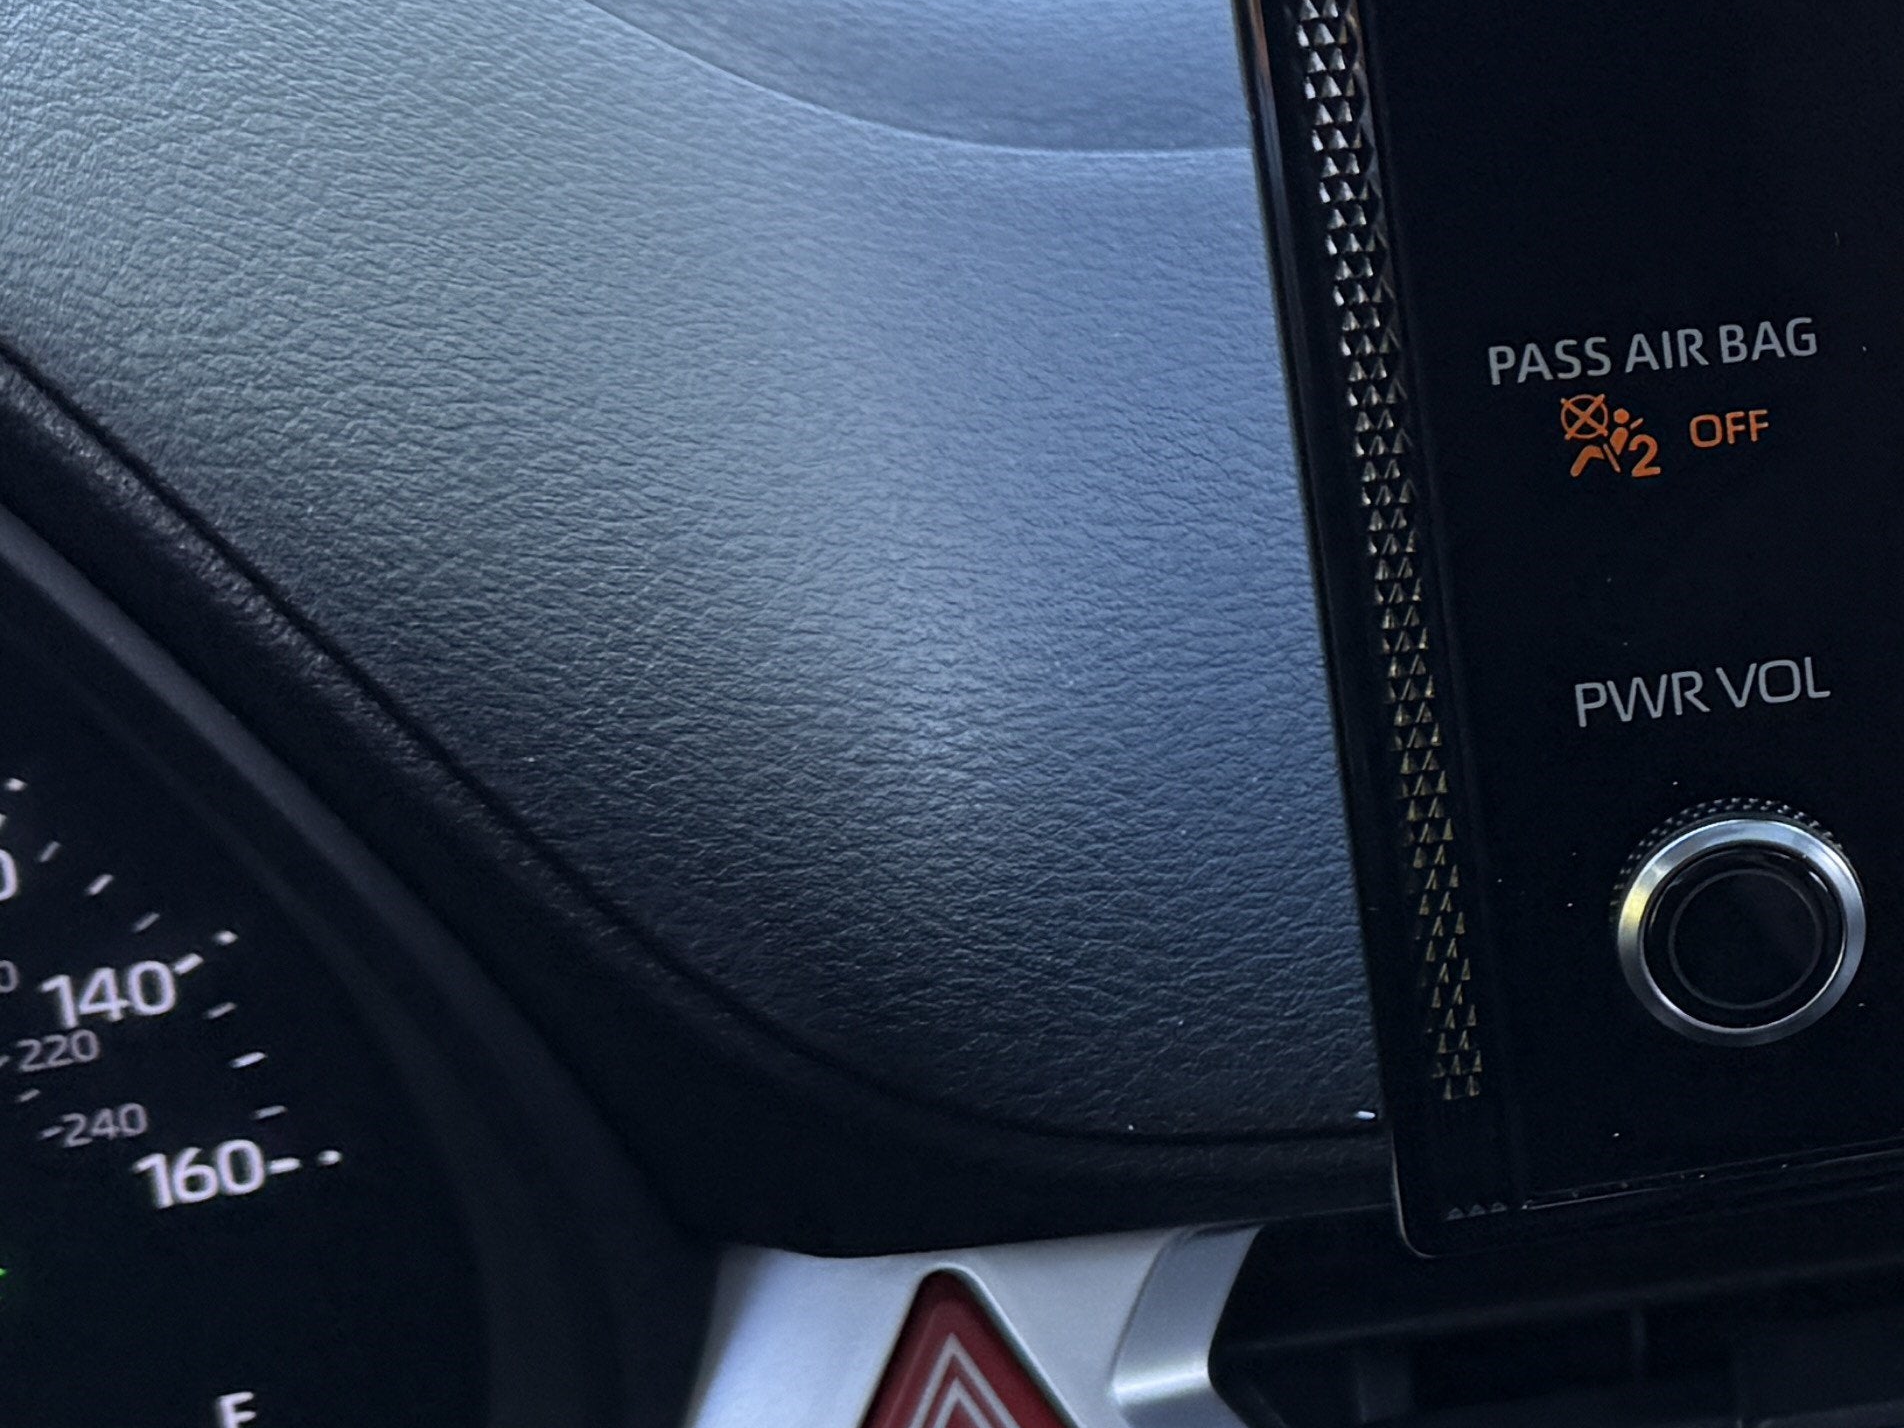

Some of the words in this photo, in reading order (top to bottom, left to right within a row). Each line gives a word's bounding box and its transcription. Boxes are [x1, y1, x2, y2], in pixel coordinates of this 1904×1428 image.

[1488, 336, 1612, 386] PASS
[1624, 328, 1710, 373] AIR
[1718, 316, 1818, 364] BAG
[1689, 408, 1770, 448] OFF
[1574, 670, 1711, 728] PWR
[1715, 656, 1831, 709] VOL
[41, 960, 176, 1029] 140
[15, 1029, 100, 1073] 220
[135, 1139, 266, 1208] 160
